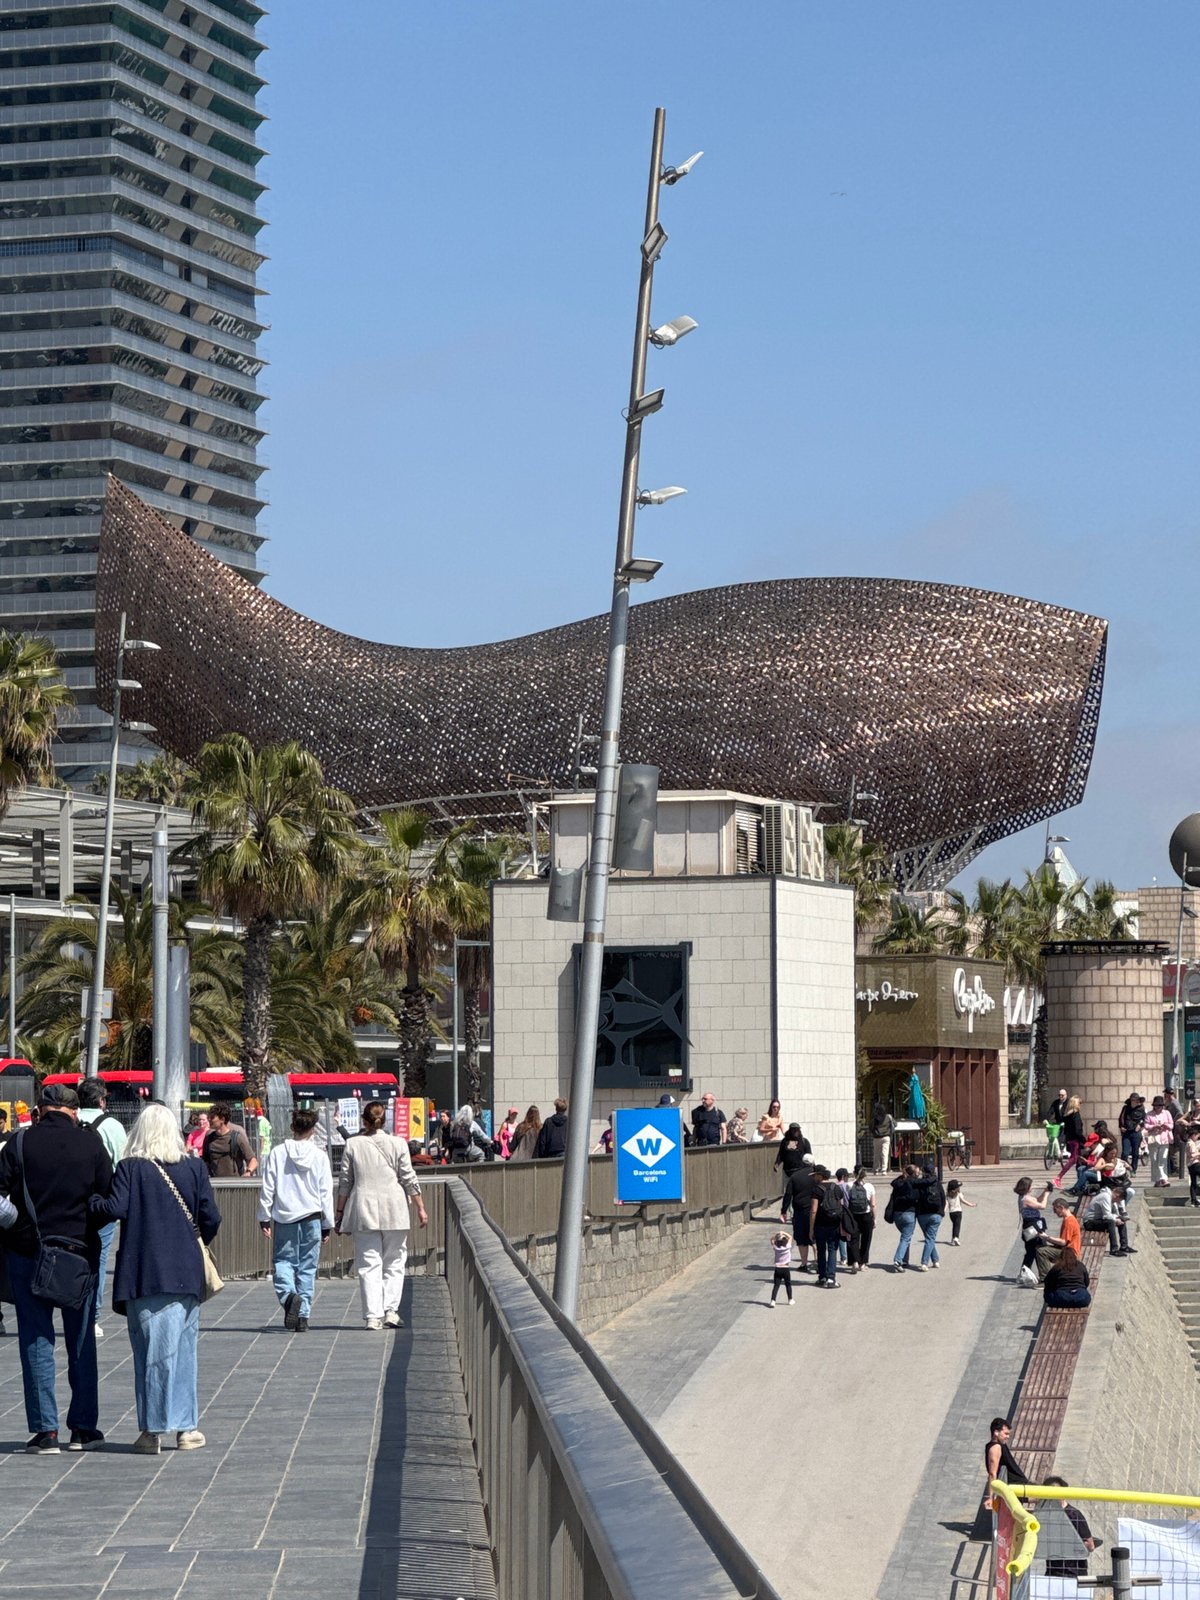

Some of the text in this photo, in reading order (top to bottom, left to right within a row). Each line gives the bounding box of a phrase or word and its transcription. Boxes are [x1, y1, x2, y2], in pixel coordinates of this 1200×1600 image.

[855, 981, 919, 1012] arpe Diem
[636, 1137, 662, 1156] W
